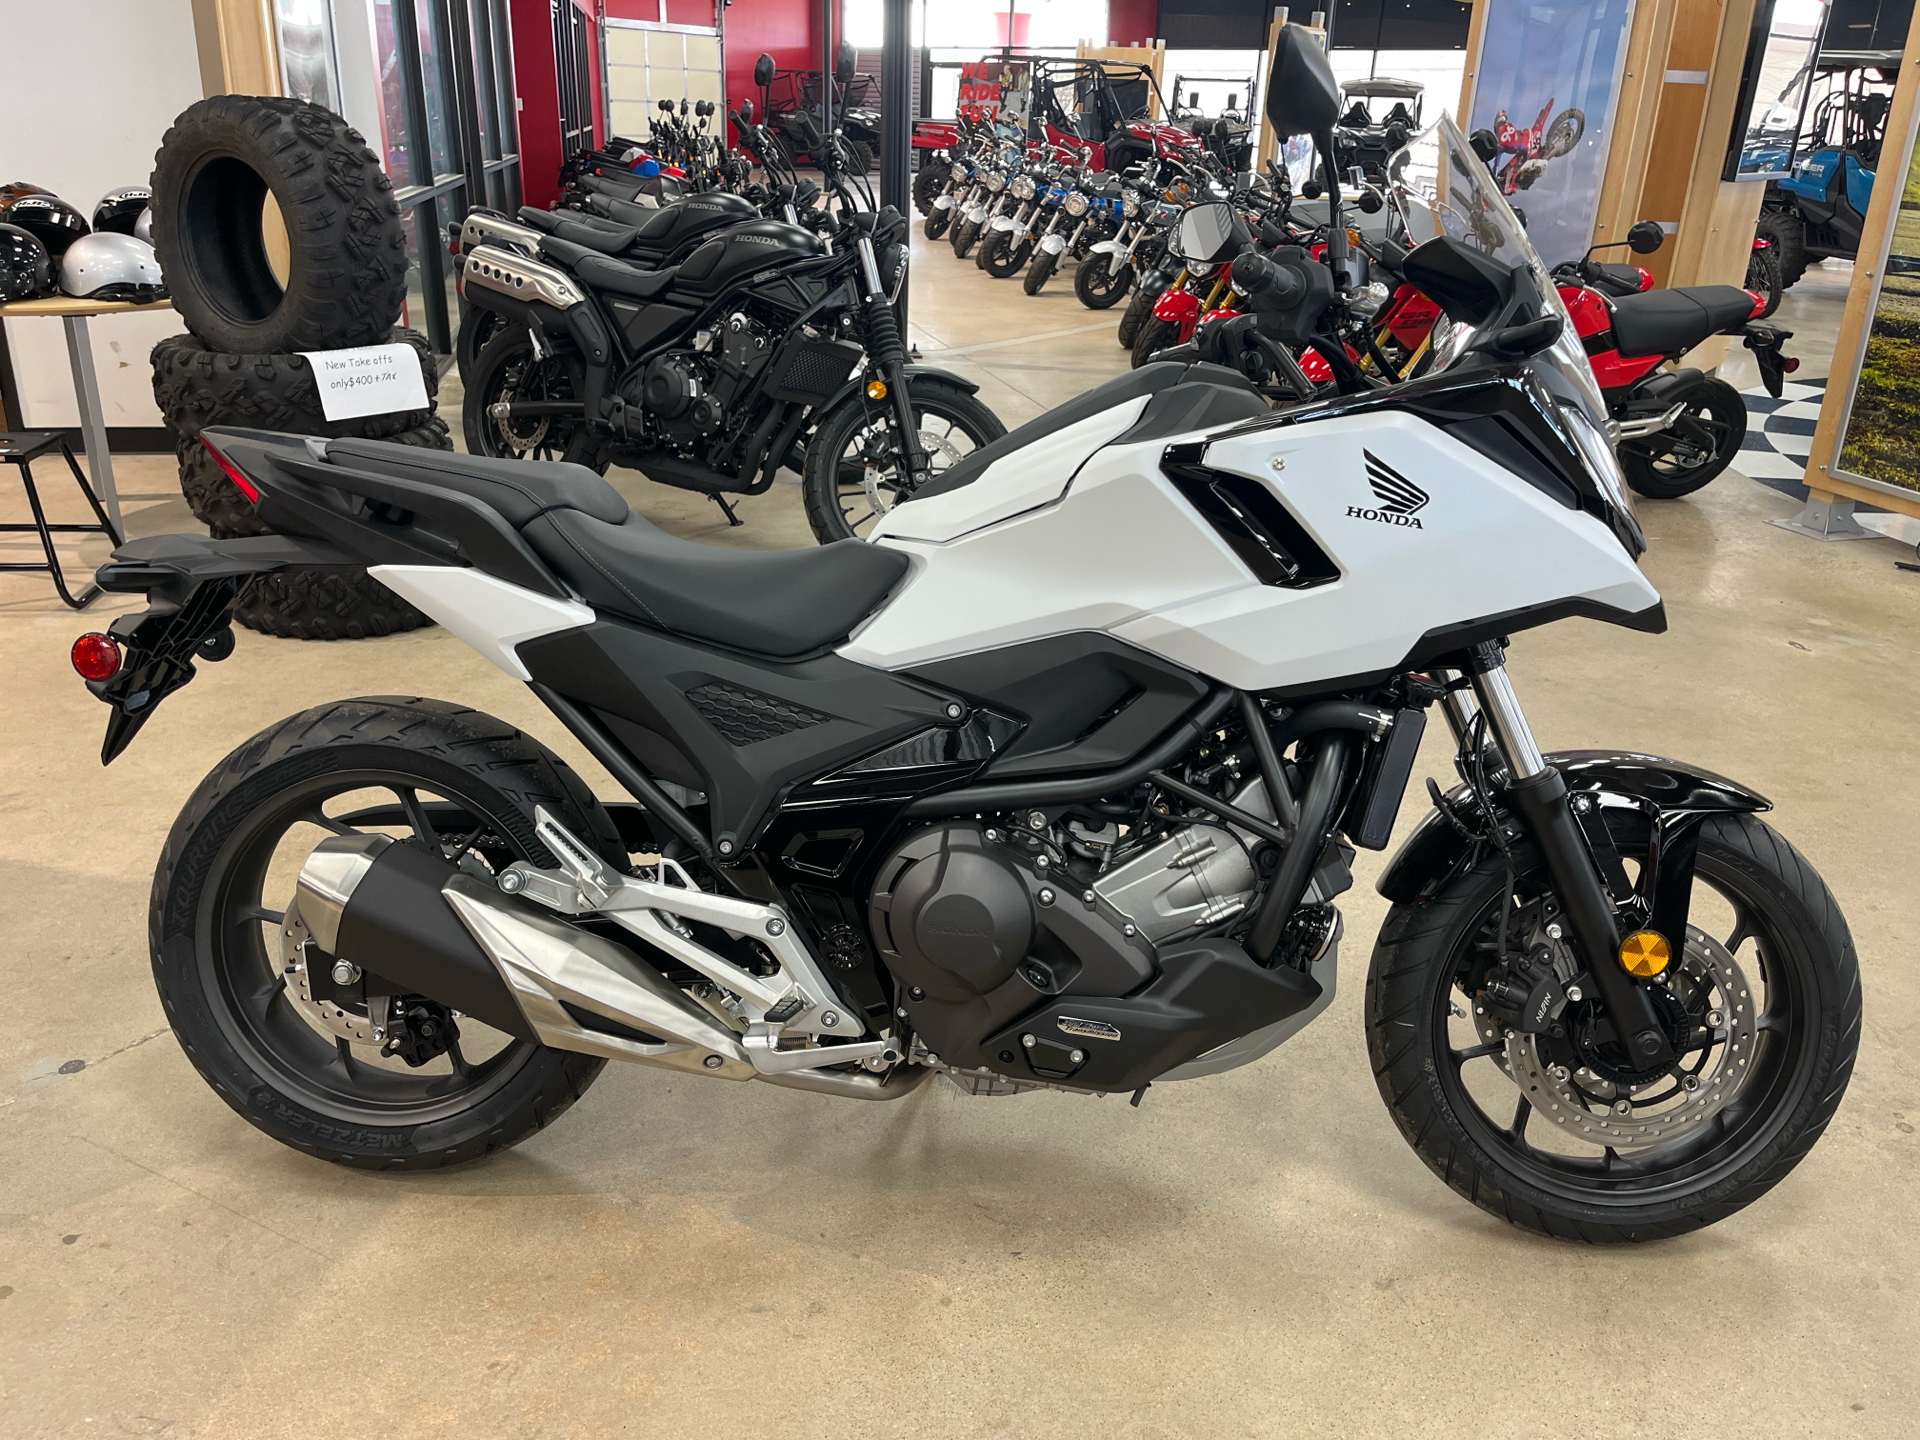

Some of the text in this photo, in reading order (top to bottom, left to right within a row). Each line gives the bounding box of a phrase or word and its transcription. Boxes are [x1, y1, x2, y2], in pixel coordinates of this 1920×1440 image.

[962, 62, 989, 79] WE
[960, 83, 1000, 101] RIDE
[687, 203, 724, 212] HONDA
[735, 235, 780, 246] HONDA
[325, 355, 393, 370] New Take offs
[1345, 506, 1424, 530] HONDA
[928, 925, 990, 938] HONDA
[1535, 992, 1552, 1023] NISSIN
[1065, 1026, 1119, 1038] Transmission
[274, 1102, 403, 1149] METZELER
